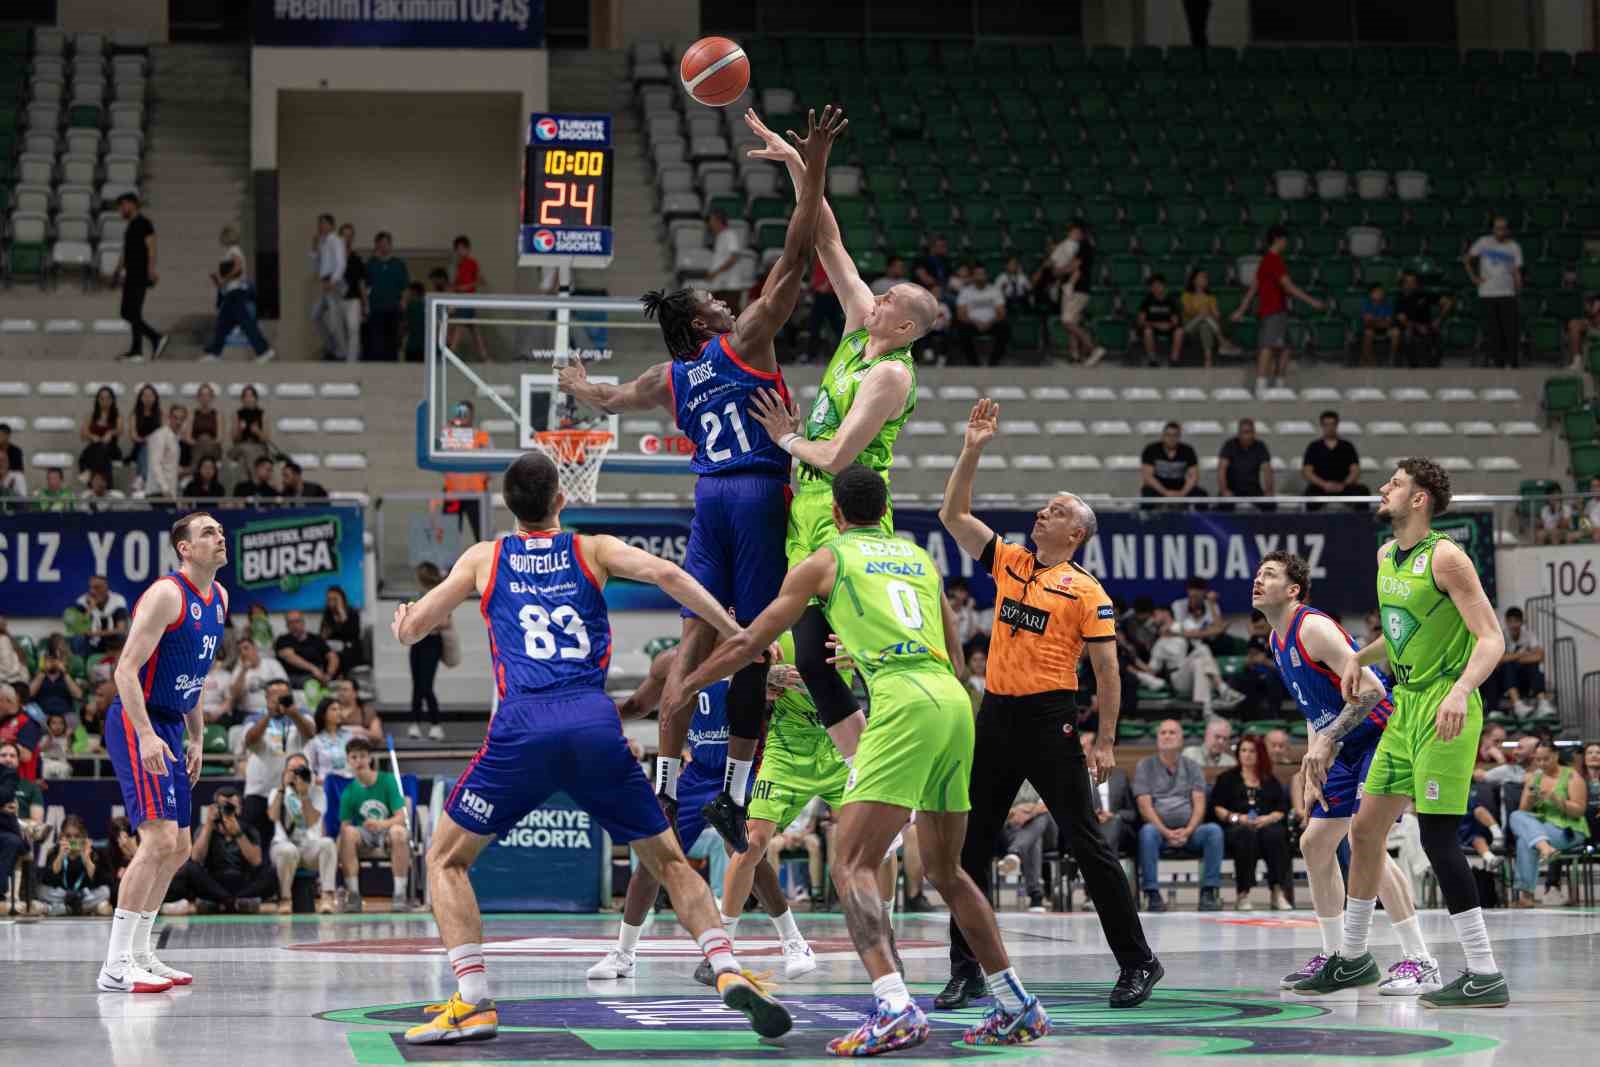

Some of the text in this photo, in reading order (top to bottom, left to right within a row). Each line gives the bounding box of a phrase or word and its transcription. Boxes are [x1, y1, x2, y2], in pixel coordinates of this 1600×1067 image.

[545, 150, 604, 176] 10:00
[540, 181, 595, 226] 24
[700, 401, 752, 463] 21
[243, 541, 333, 581] BURSA
[510, 551, 570, 574] BOUTEILLE
[1083, 533, 1327, 579] ANINDAYIZ
[1545, 560, 1596, 596] 106
[886, 580, 924, 630] 0
[198, 634, 217, 660] 34
[519, 604, 591, 659] 83
[698, 691, 710, 715] 0
[1292, 681, 1308, 706] 2
[462, 788, 494, 819] HDI
